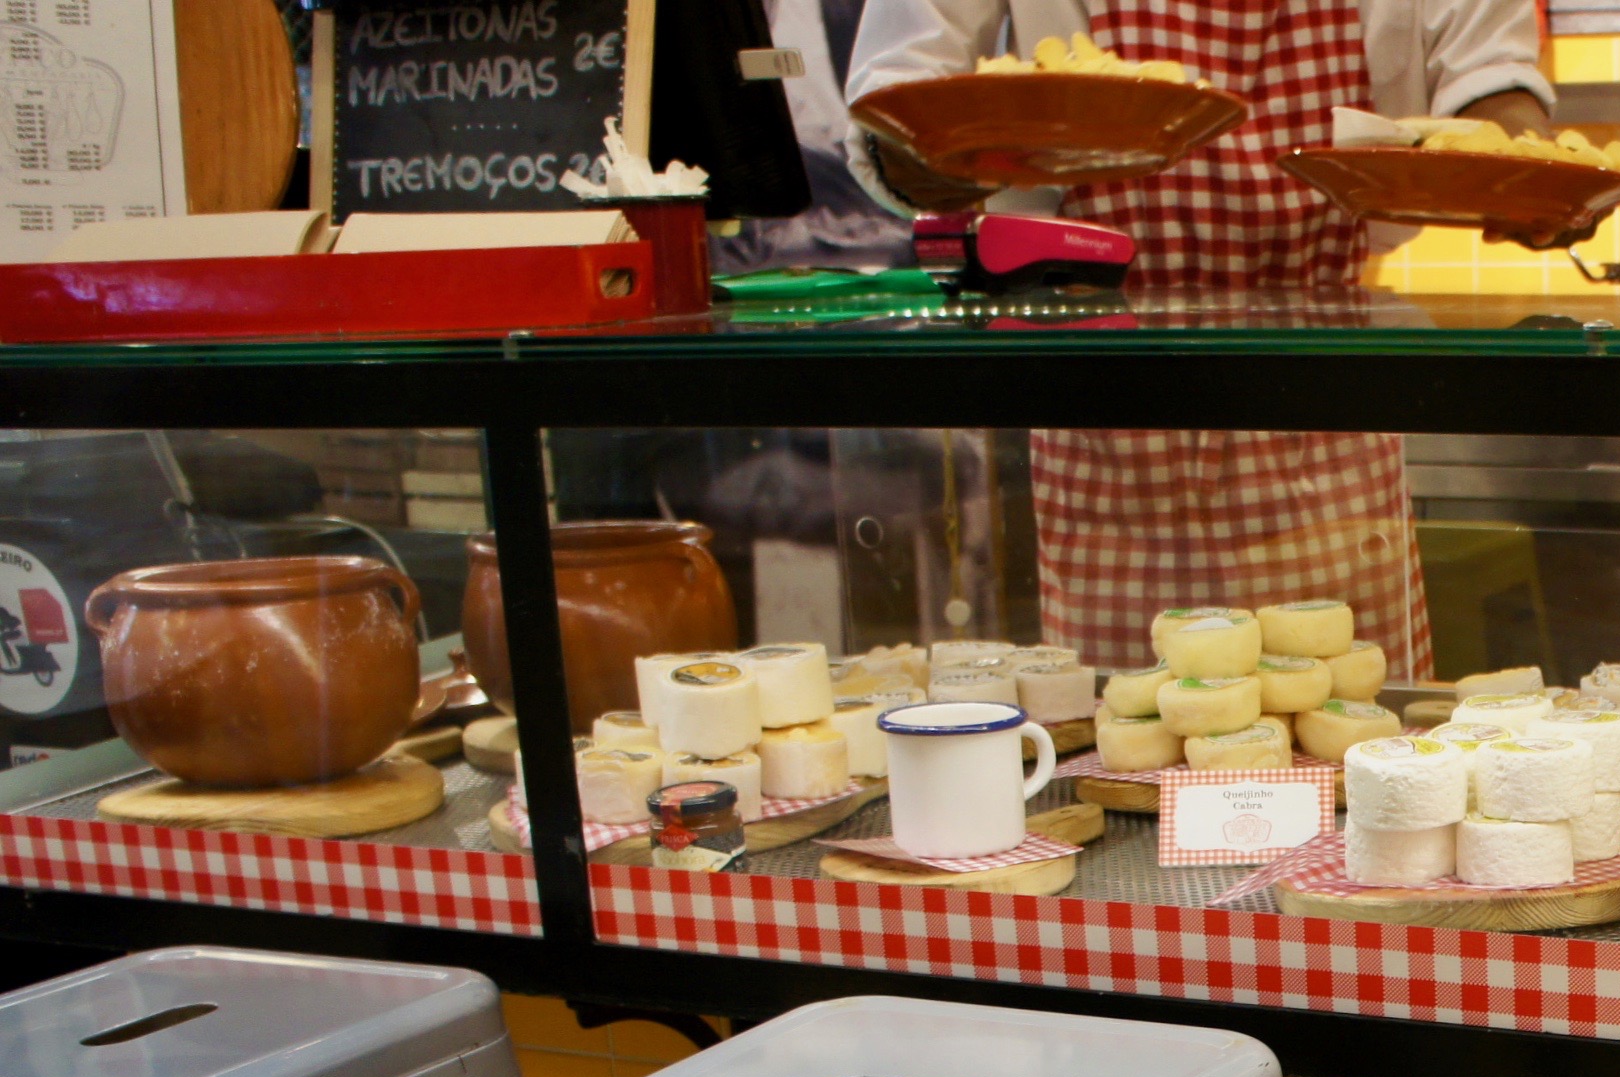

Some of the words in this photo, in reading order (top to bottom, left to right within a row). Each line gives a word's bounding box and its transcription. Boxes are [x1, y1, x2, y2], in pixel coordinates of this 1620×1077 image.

[349, 1, 558, 55] AZEITONAS
[573, 32, 621, 72] 2€
[349, 55, 558, 107] MARINADAS
[347, 152, 558, 200] TREMOÇOS
[1222, 790, 1273, 800] Queijinho
[1232, 801, 1263, 810] Cabra
